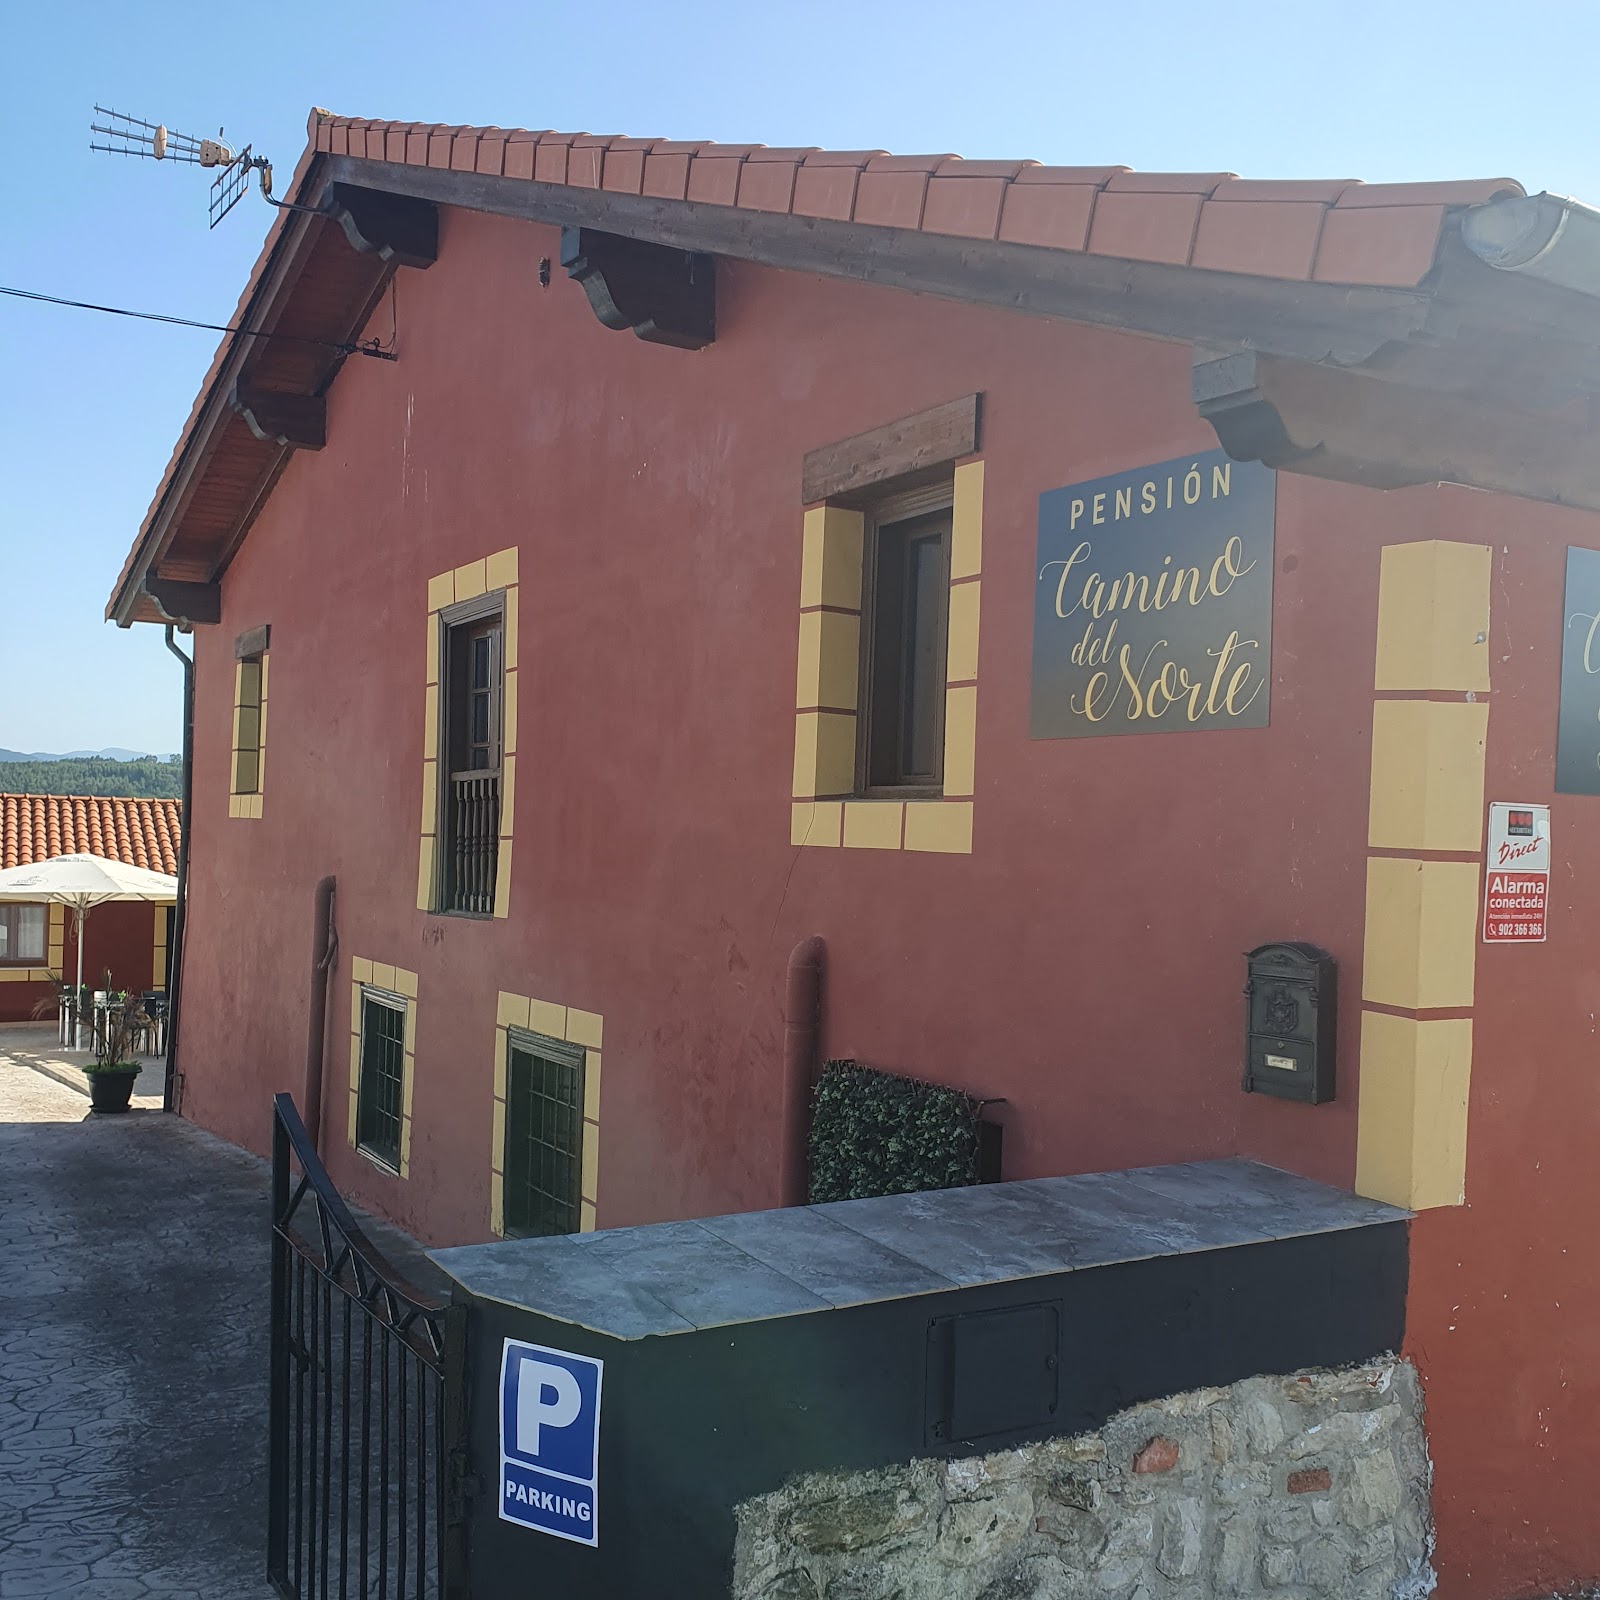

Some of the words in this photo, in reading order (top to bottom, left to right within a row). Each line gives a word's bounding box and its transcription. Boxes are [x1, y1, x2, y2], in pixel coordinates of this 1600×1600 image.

[1070, 463, 1231, 530] PENSIÓN
[1039, 536, 1257, 619] Camino
[1071, 618, 1118, 666] del
[1070, 630, 1265, 722] Norte
[1498, 836, 1544, 864] Direct
[1489, 895, 1544, 909] conectada
[1490, 876, 1544, 894] Alarma
[1498, 923, 1513, 936] 902
[1514, 923, 1528, 936] 366
[1528, 923, 1542, 936] 366
[517, 1357, 582, 1456] P
[506, 1479, 591, 1522] PARKING
